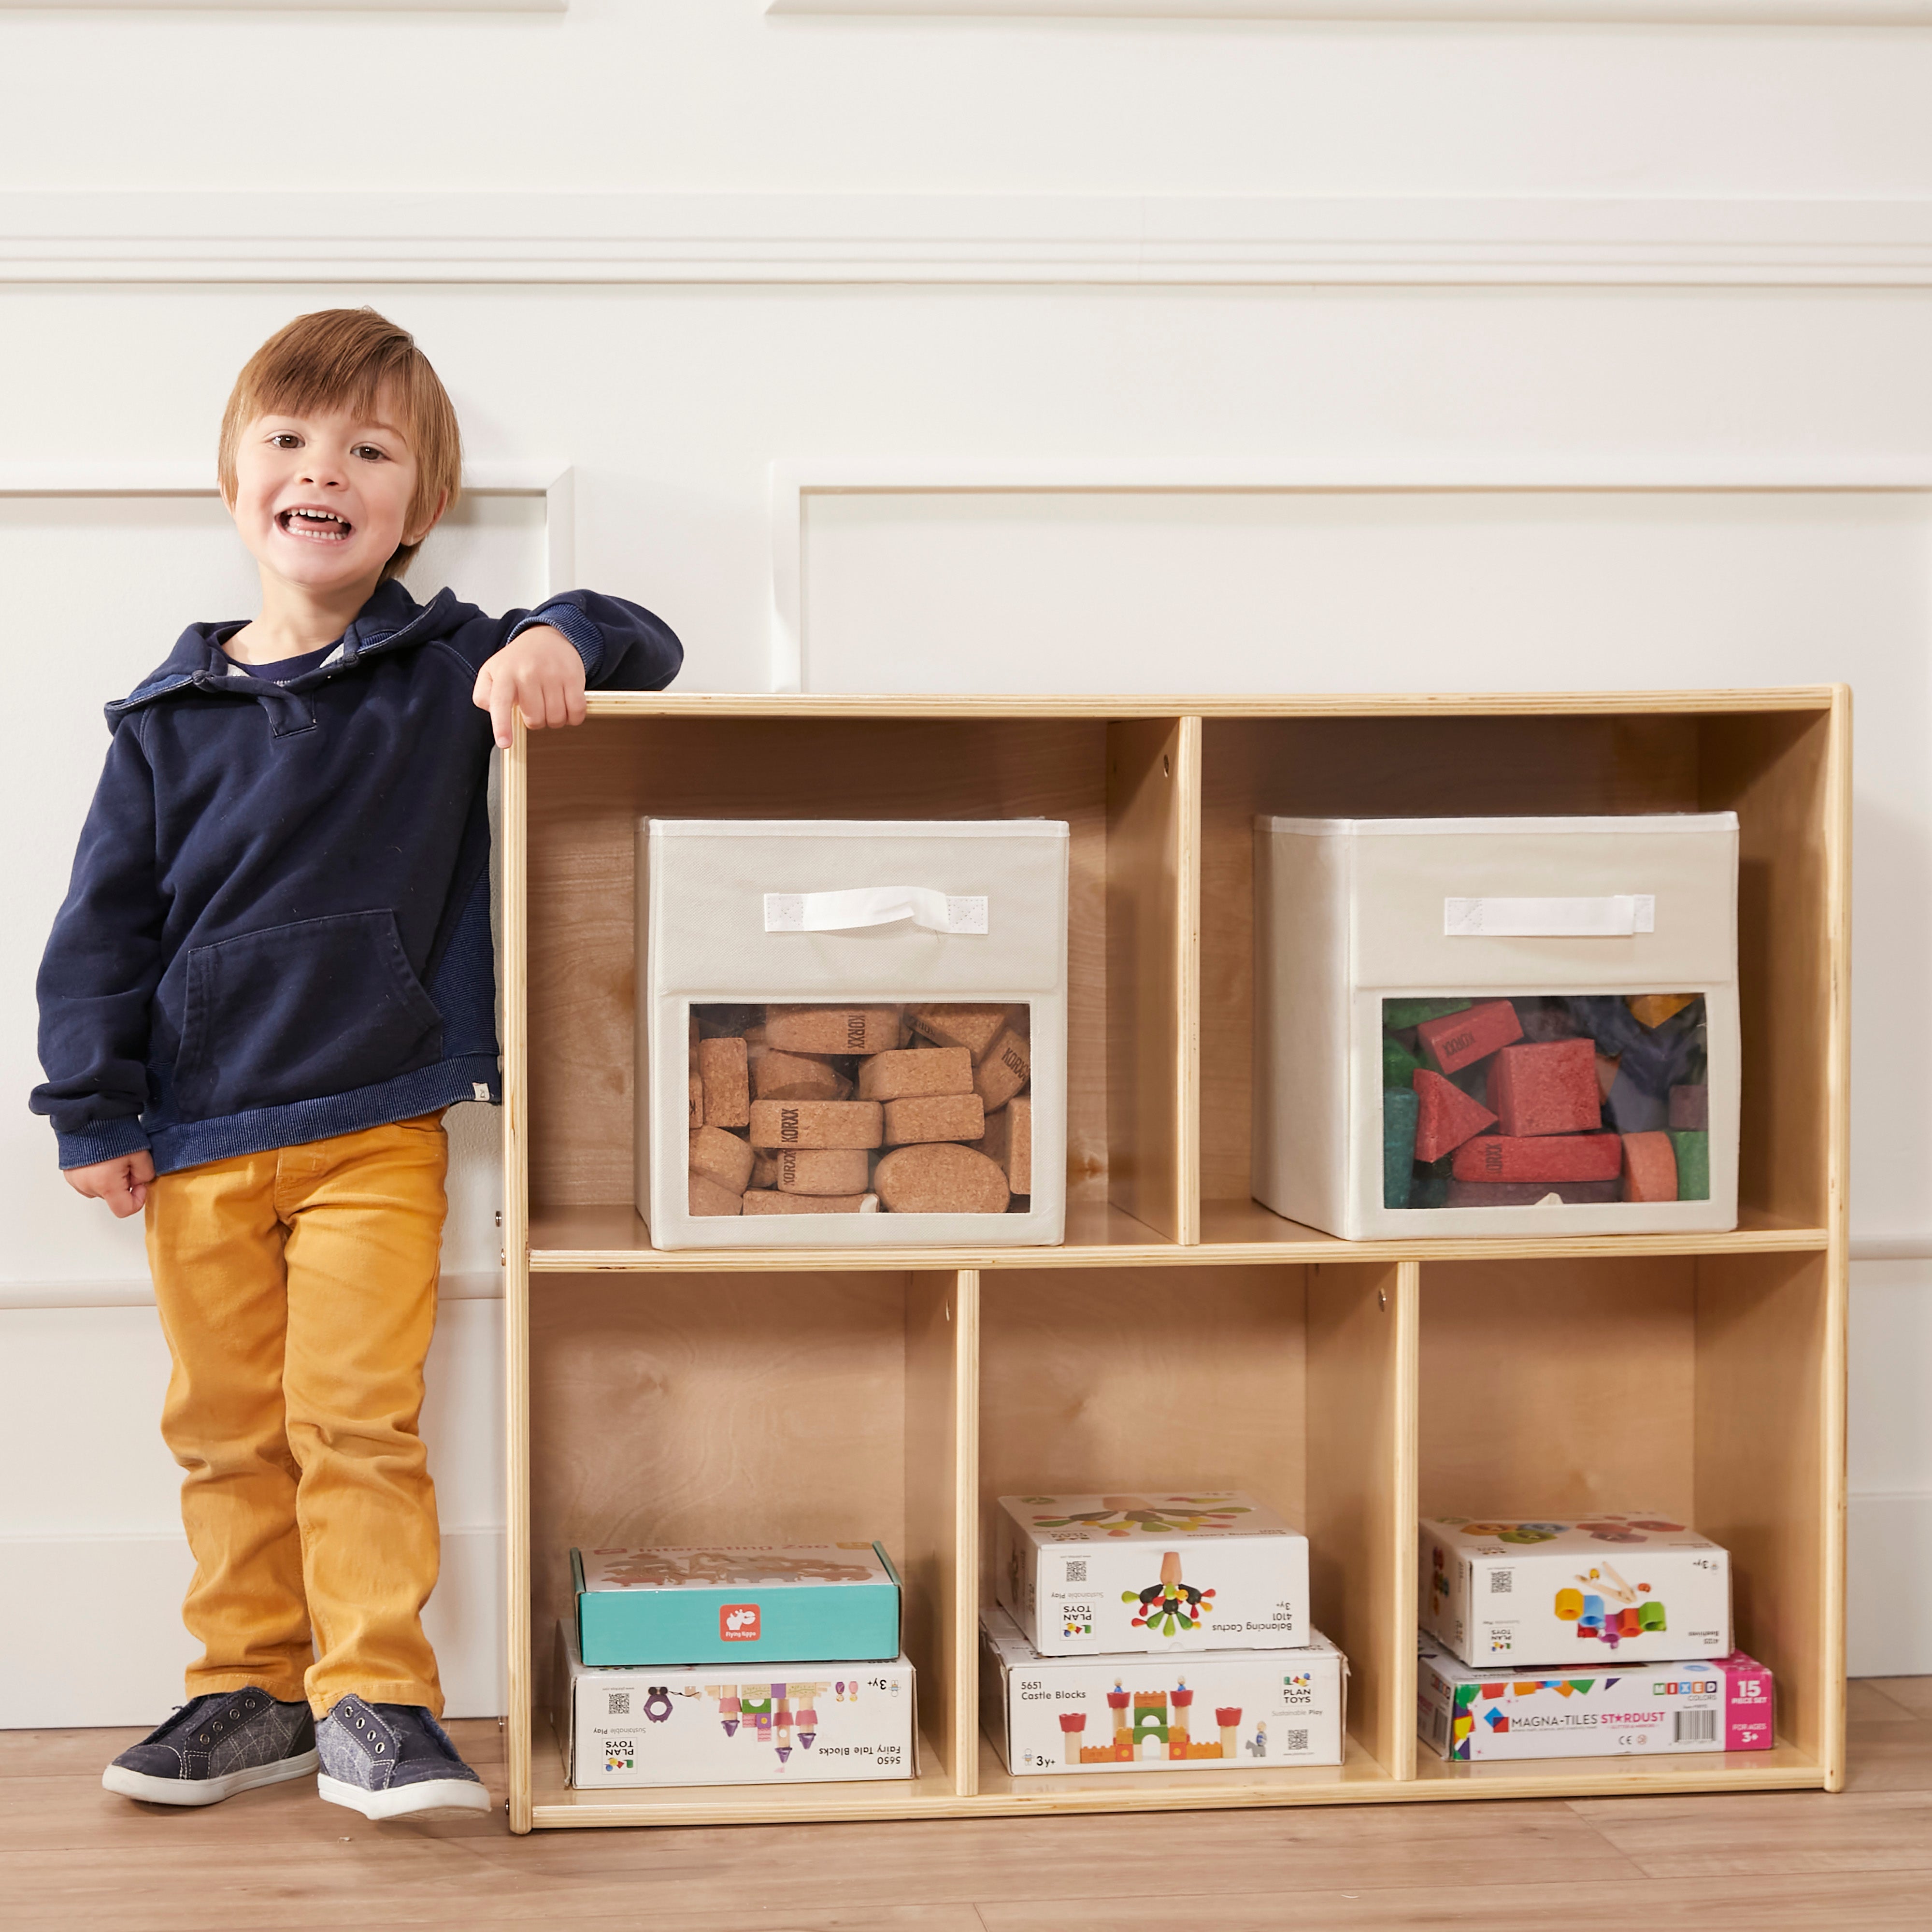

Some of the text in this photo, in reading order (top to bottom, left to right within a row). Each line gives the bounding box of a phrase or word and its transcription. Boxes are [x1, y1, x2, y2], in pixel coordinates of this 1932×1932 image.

[848, 1015, 865, 1049] KORXX
[1442, 1030, 1475, 1058] KORXX
[781, 1108, 799, 1143] KORXX
[1276, 1601, 1290, 1610] 3y+
[1246, 1622, 1292, 1631] Balancing
[867, 1678, 887, 1690] 3y+
[1021, 1681, 1042, 1689] 5651
[1653, 1681, 1717, 1695] MIXED
[1737, 1680, 1761, 1697] 15
[1021, 1690, 1086, 1700] Castle Blocks
[1512, 1715, 1598, 1727] MAGNA-TILES
[1741, 1732, 1758, 1743] 3+
[819, 1745, 901, 1756] Fairy Tale Blocks
[877, 1757, 901, 1765] 5650
[1036, 1756, 1056, 1767] 3y+
